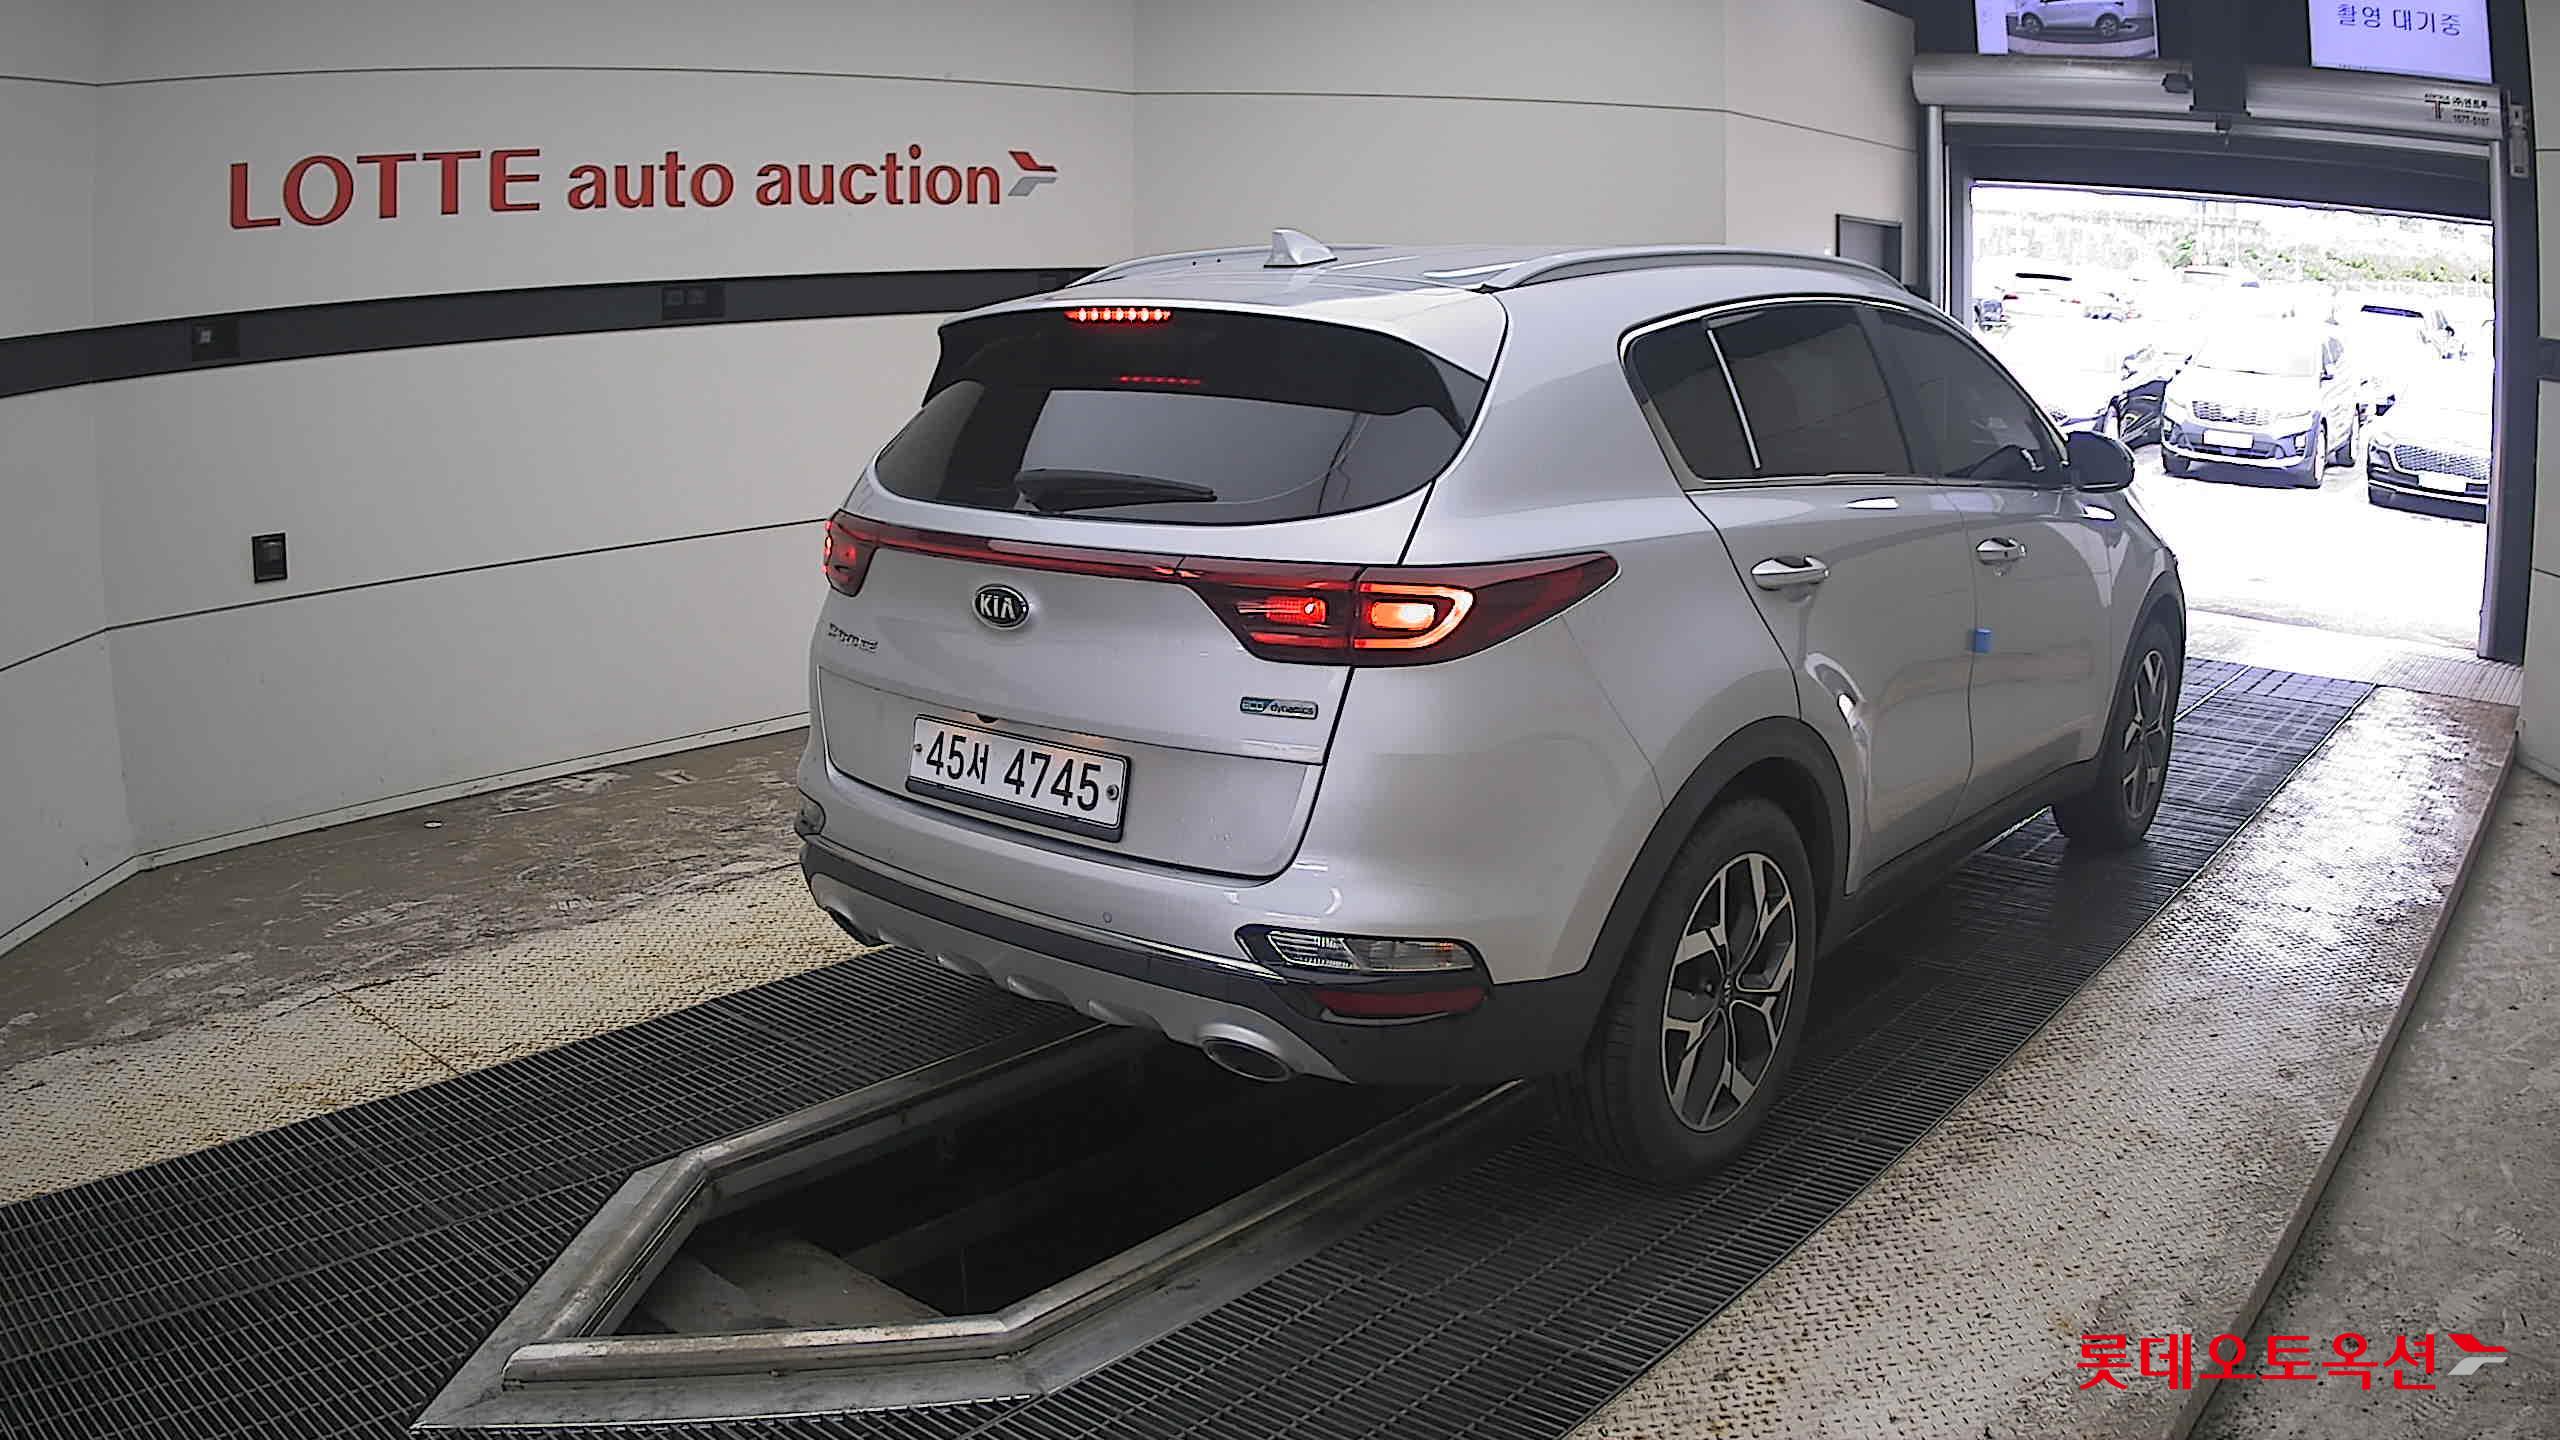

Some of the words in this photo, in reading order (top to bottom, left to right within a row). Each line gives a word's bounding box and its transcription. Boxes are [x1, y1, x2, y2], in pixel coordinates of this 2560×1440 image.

[2337, 3, 2381, 28] 촬영
[2392, 9, 2461, 36] 대기중
[230, 148, 540, 229] LOTTE
[567, 150, 735, 210] auto
[755, 144, 1001, 206] auction
[980, 593, 1016, 619] KIA
[926, 731, 990, 784] 45서
[1003, 748, 1102, 811] 4745
